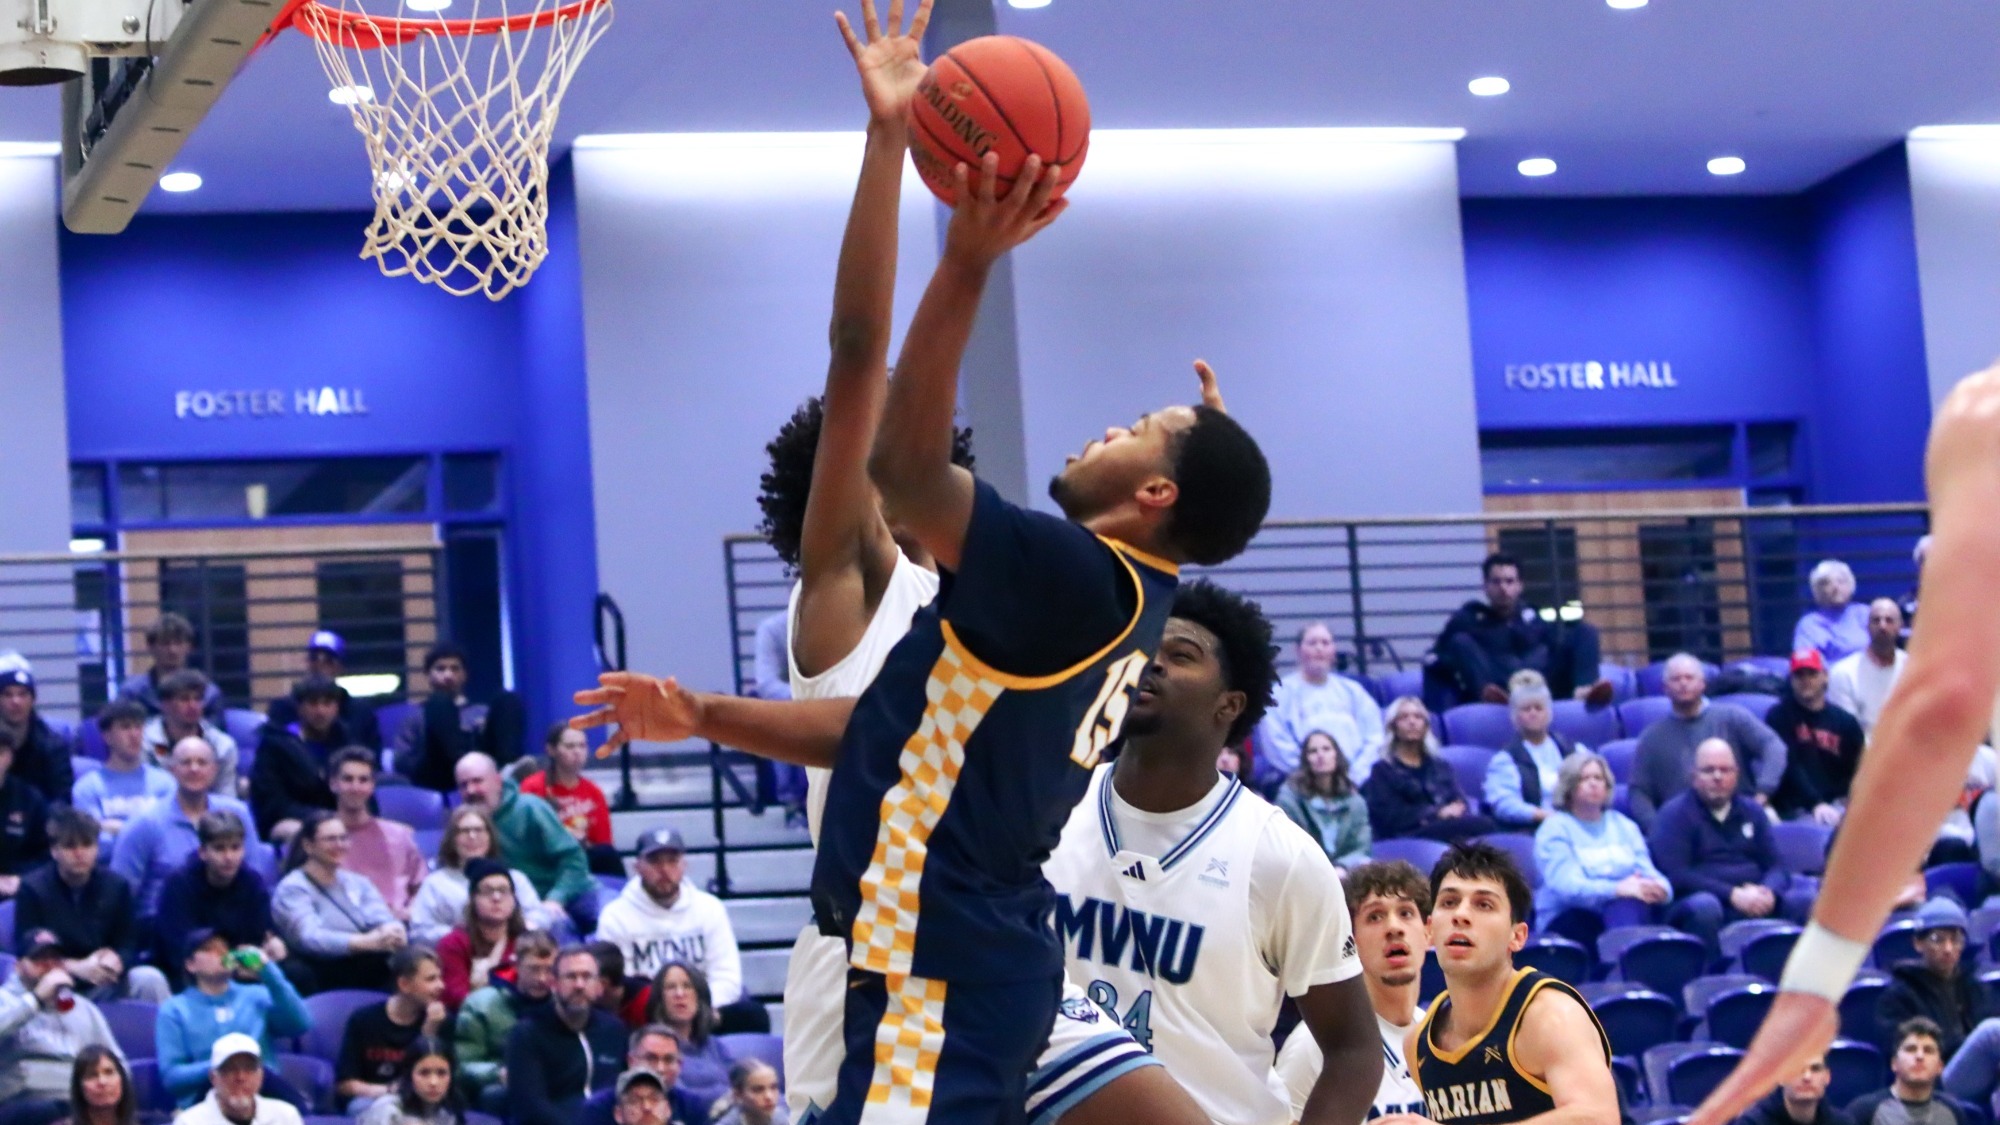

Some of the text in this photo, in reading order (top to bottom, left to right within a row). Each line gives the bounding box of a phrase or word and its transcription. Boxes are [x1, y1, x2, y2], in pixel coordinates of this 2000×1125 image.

[1504, 360, 1678, 390] FOSTER HALL
[175, 386, 368, 419] FOSTER HALL
[1069, 648, 1149, 770] 15
[631, 932, 705, 971] MVNU
[1055, 892, 1205, 986] MVNU
[1424, 1077, 1513, 1123] MARIAN
